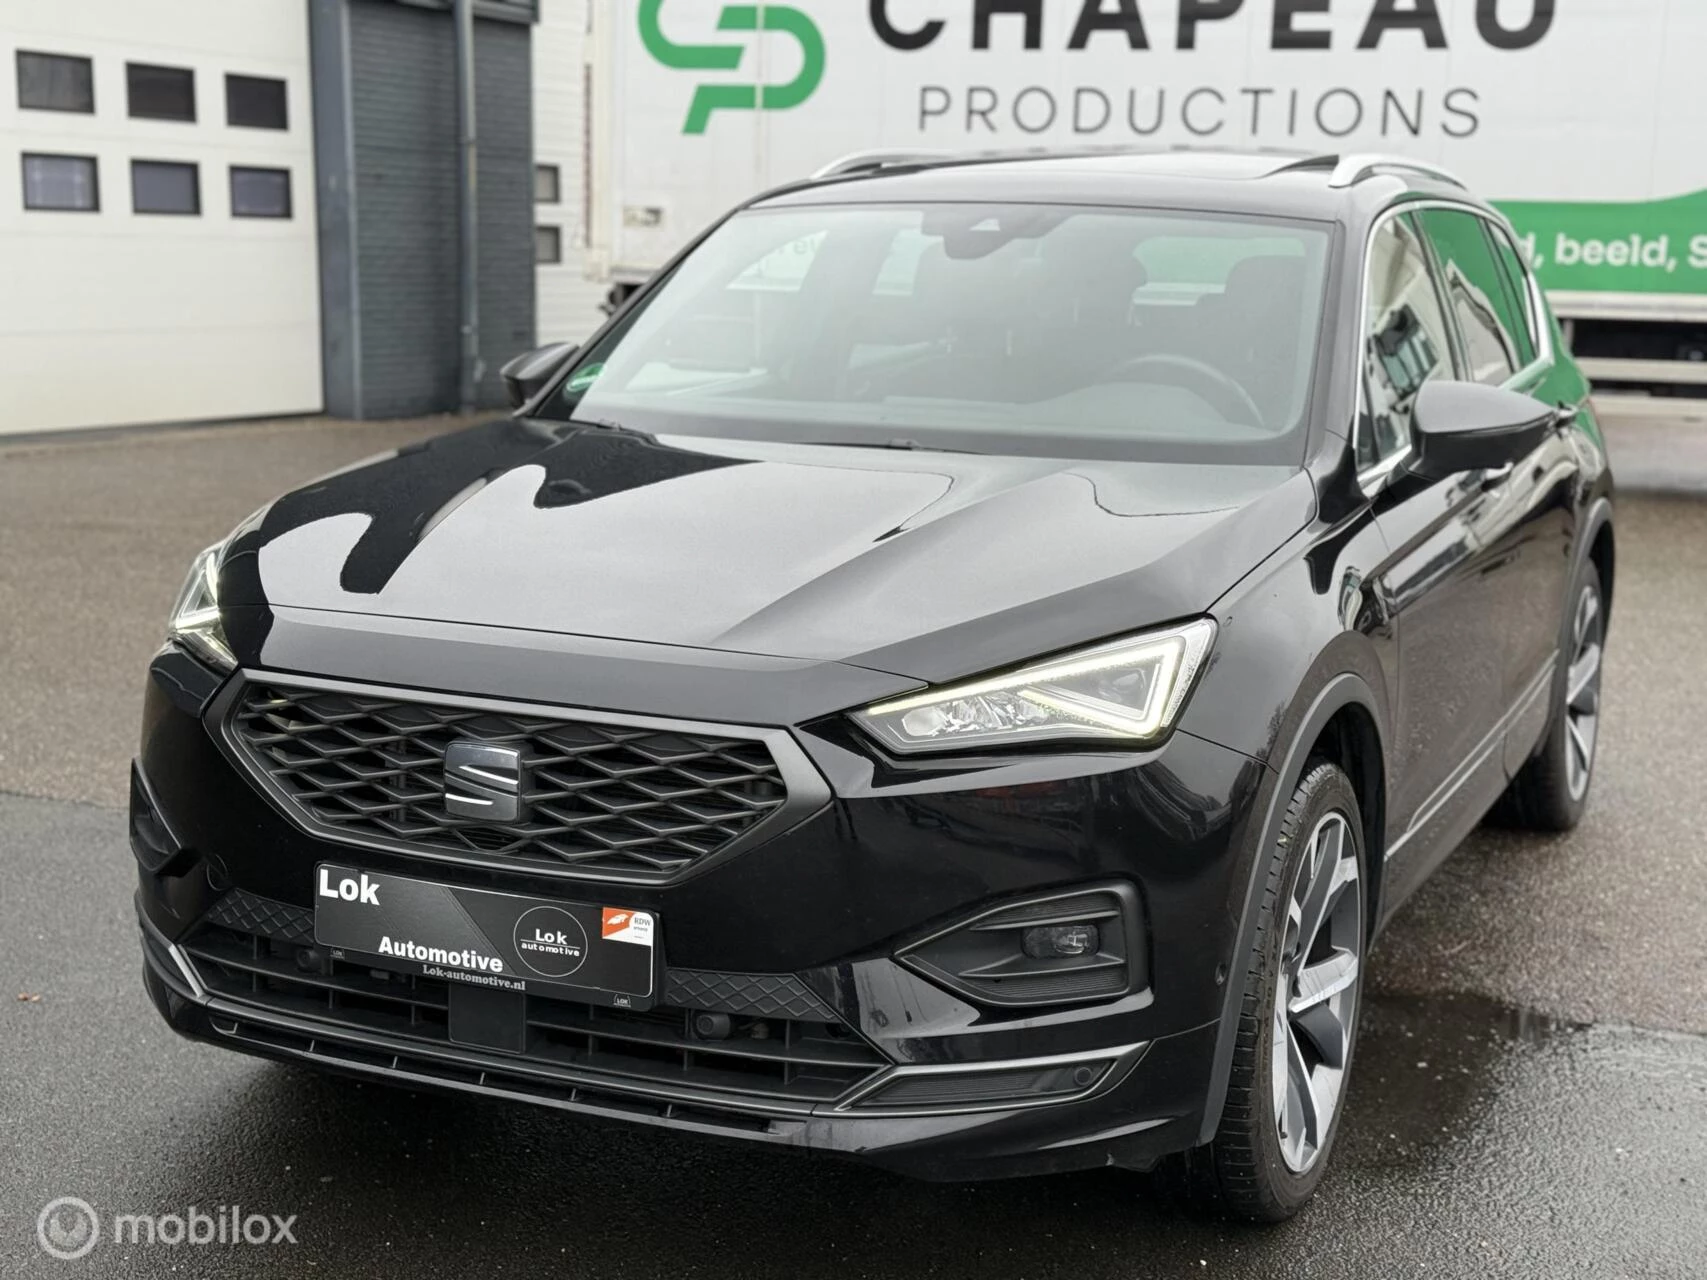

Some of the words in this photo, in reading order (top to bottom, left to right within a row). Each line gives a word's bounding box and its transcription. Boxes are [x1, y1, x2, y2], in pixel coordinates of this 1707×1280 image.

[918, 86, 1481, 138] PRODUCTIONS
[1554, 232, 1678, 273] beeld,
[319, 868, 380, 905] Lok
[378, 936, 504, 973] Automotive
[521, 942, 580, 957] automotive
[535, 928, 568, 945] Lok
[422, 964, 526, 991] Lok-automotive.nl
